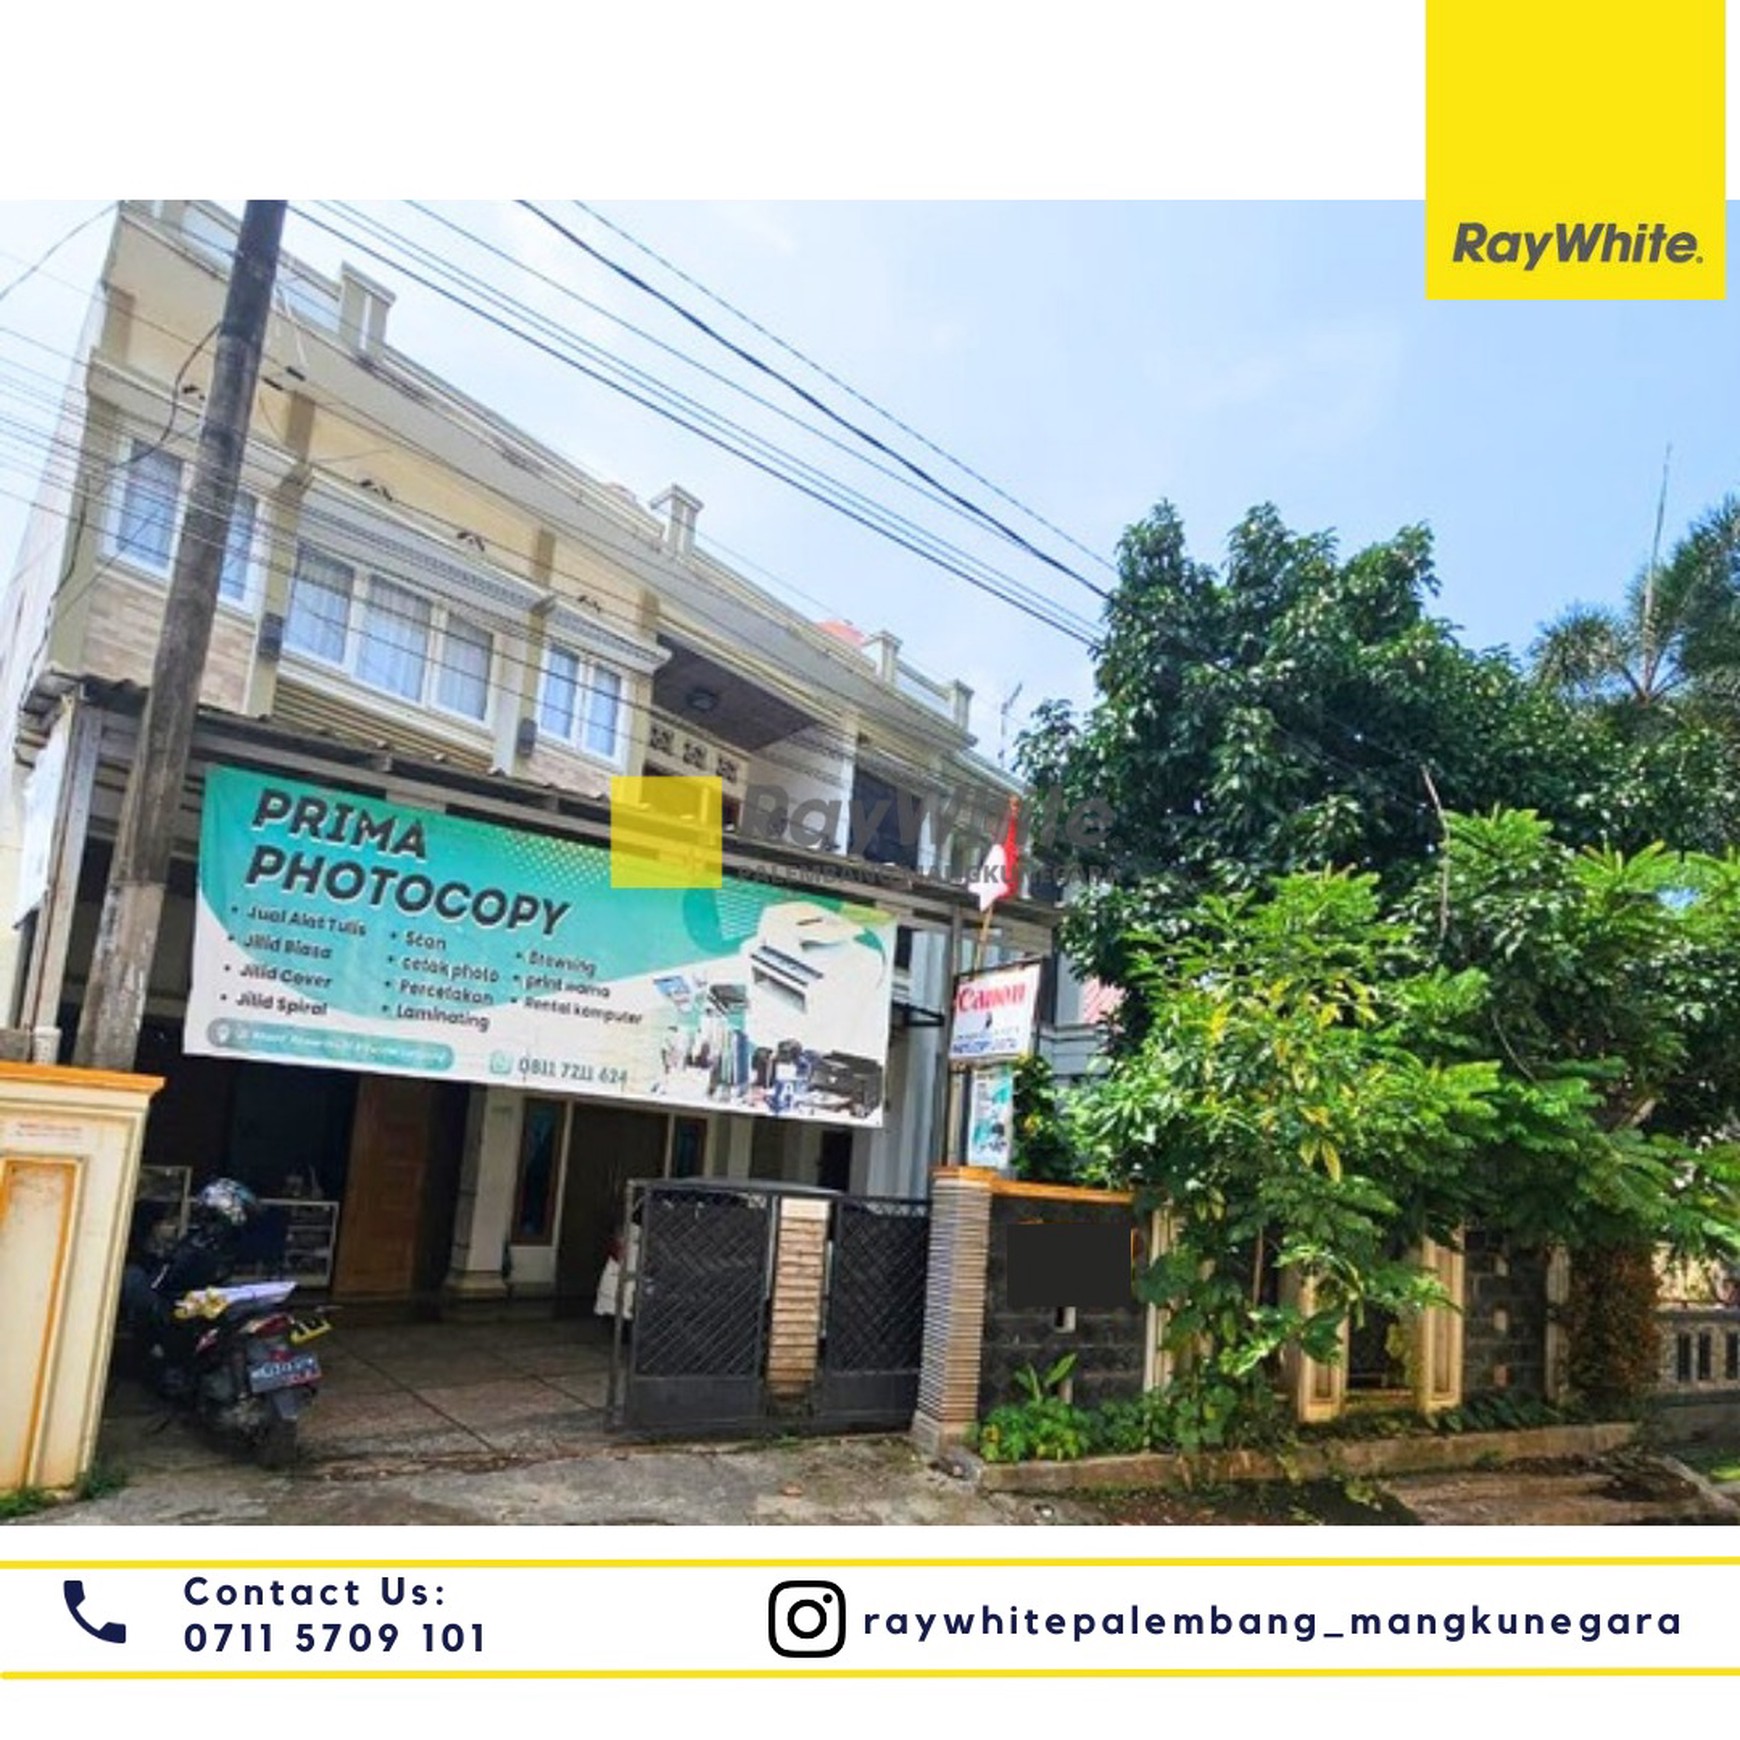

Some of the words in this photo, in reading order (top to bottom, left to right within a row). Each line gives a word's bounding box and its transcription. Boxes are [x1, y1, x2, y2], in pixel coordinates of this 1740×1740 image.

[251, 787, 427, 862] PRIMA
[244, 844, 572, 938] PHOTOCOPY
[247, 906, 286, 923] Jual
[288, 910, 325, 928] Alat
[328, 918, 367, 936] Tulis
[243, 933, 281, 951] Jilid
[284, 939, 333, 959] Biasa
[405, 930, 447, 950] Scan
[240, 963, 277, 980] Jilid
[279, 969, 333, 988] Cover
[451, 964, 500, 983] photo
[236, 992, 274, 1010] Jilid
[275, 995, 328, 1016] Spiral
[399, 979, 495, 1005] Percetakan
[958, 983, 1026, 1012] Canon
[397, 1003, 490, 1033] Laminating
